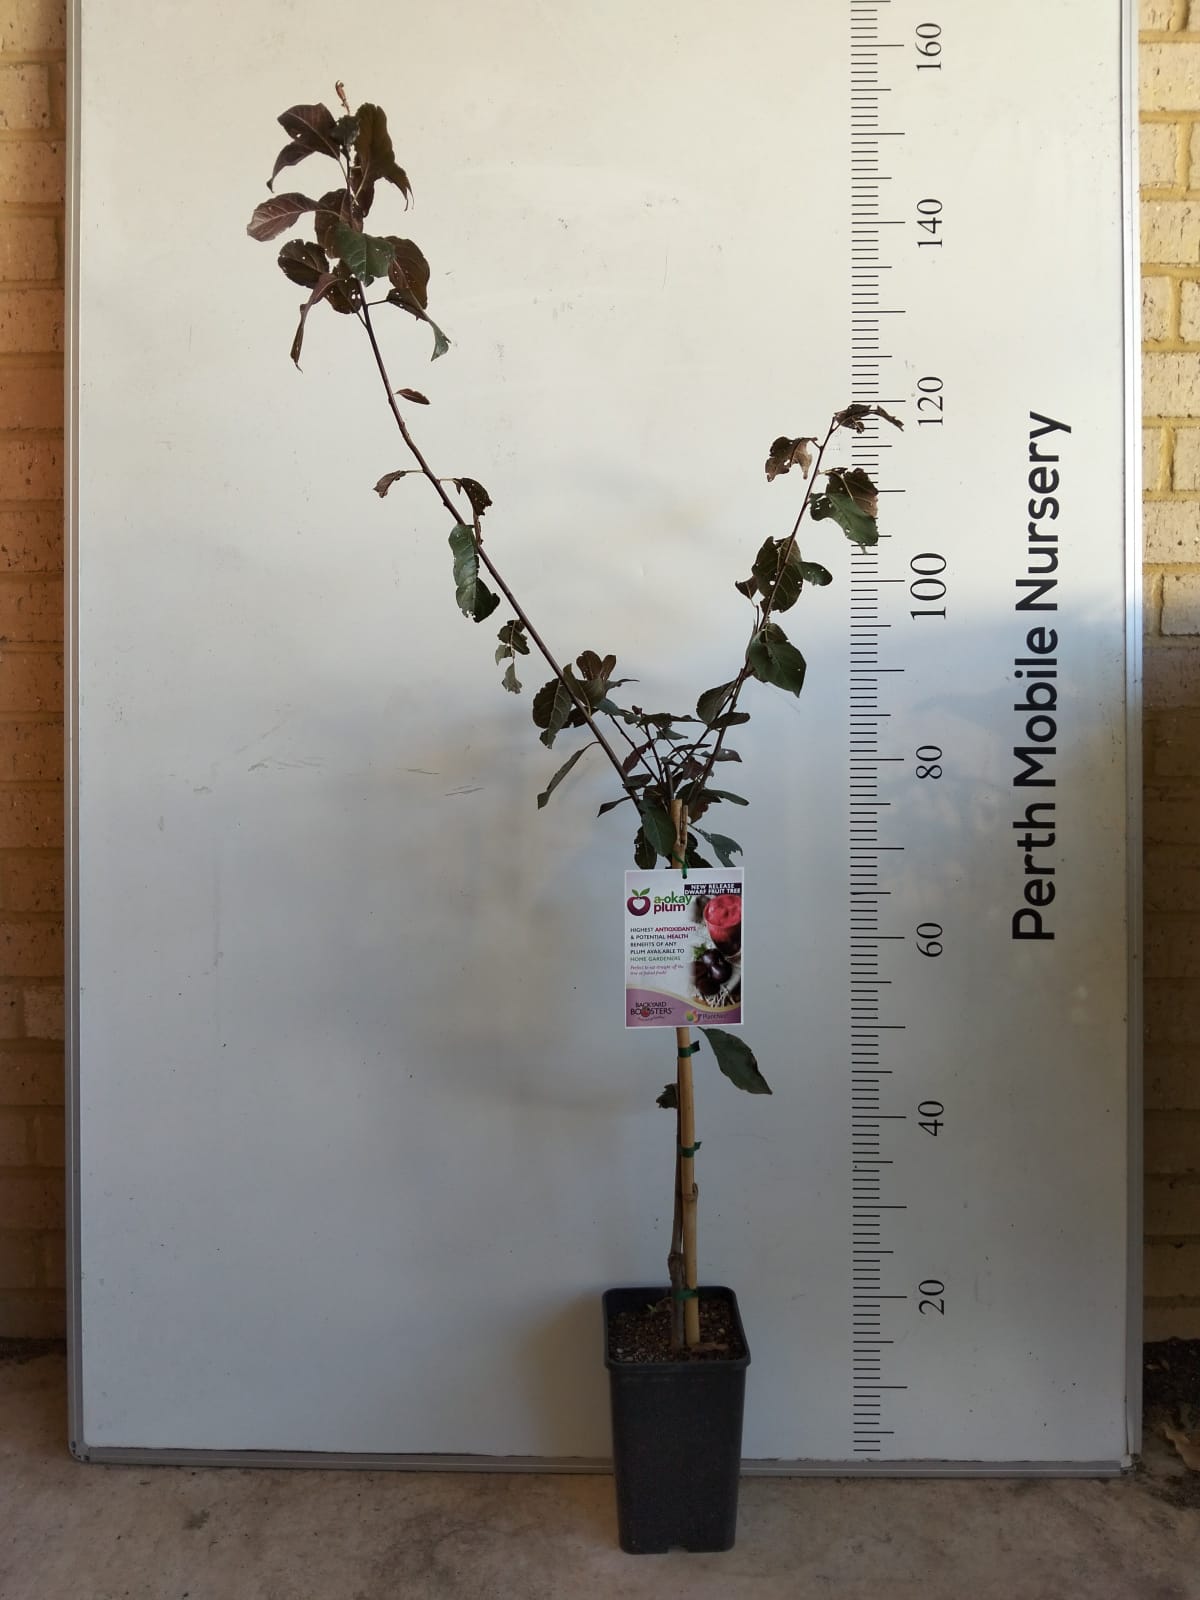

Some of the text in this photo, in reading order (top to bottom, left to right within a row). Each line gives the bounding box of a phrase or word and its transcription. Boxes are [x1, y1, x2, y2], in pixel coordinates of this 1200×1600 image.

[914, 22, 942, 72] 160
[916, 198, 943, 249] 140
[917, 376, 944, 427] 120
[910, 552, 947, 620] 100
[1012, 411, 1072, 940] Perth Mobile Nursery
[916, 744, 943, 780] 80
[653, 902, 685, 914] plum
[654, 891, 692, 905] a-okay
[916, 922, 944, 958] 60
[917, 1100, 945, 1137] 40
[918, 1279, 945, 1316] 20
